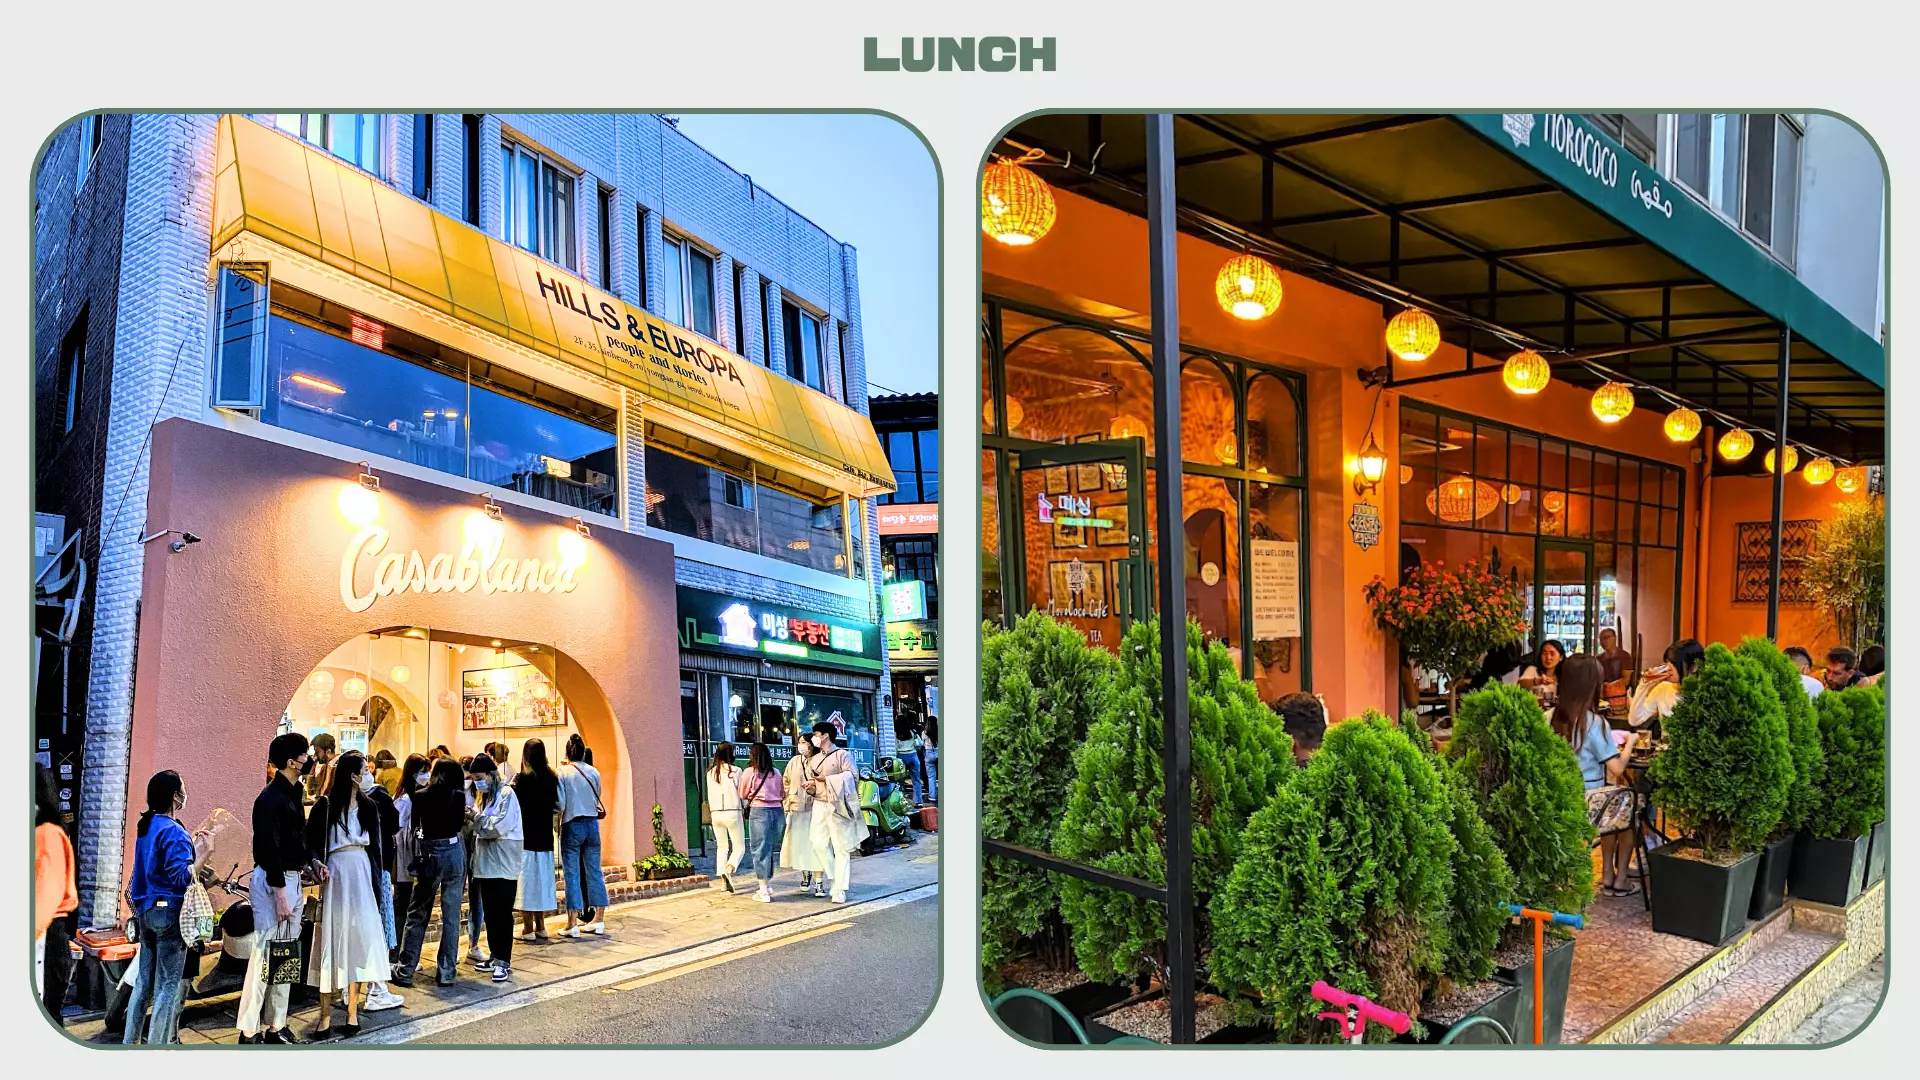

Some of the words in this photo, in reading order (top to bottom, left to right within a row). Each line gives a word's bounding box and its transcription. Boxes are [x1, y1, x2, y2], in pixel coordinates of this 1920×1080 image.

[536, 271, 621, 331] HILLS
[627, 314, 648, 345] &
[647, 323, 745, 388] EUROPA
[606, 335, 646, 360] people
[649, 354, 671, 370] and
[672, 363, 708, 386] stories
[340, 523, 578, 614] Casablanca
[762, 612, 789, 640] 미성
[789, 618, 830, 646] 부동산
[735, 745, 751, 756] Realt
[776, 748, 792, 759] 부동산
